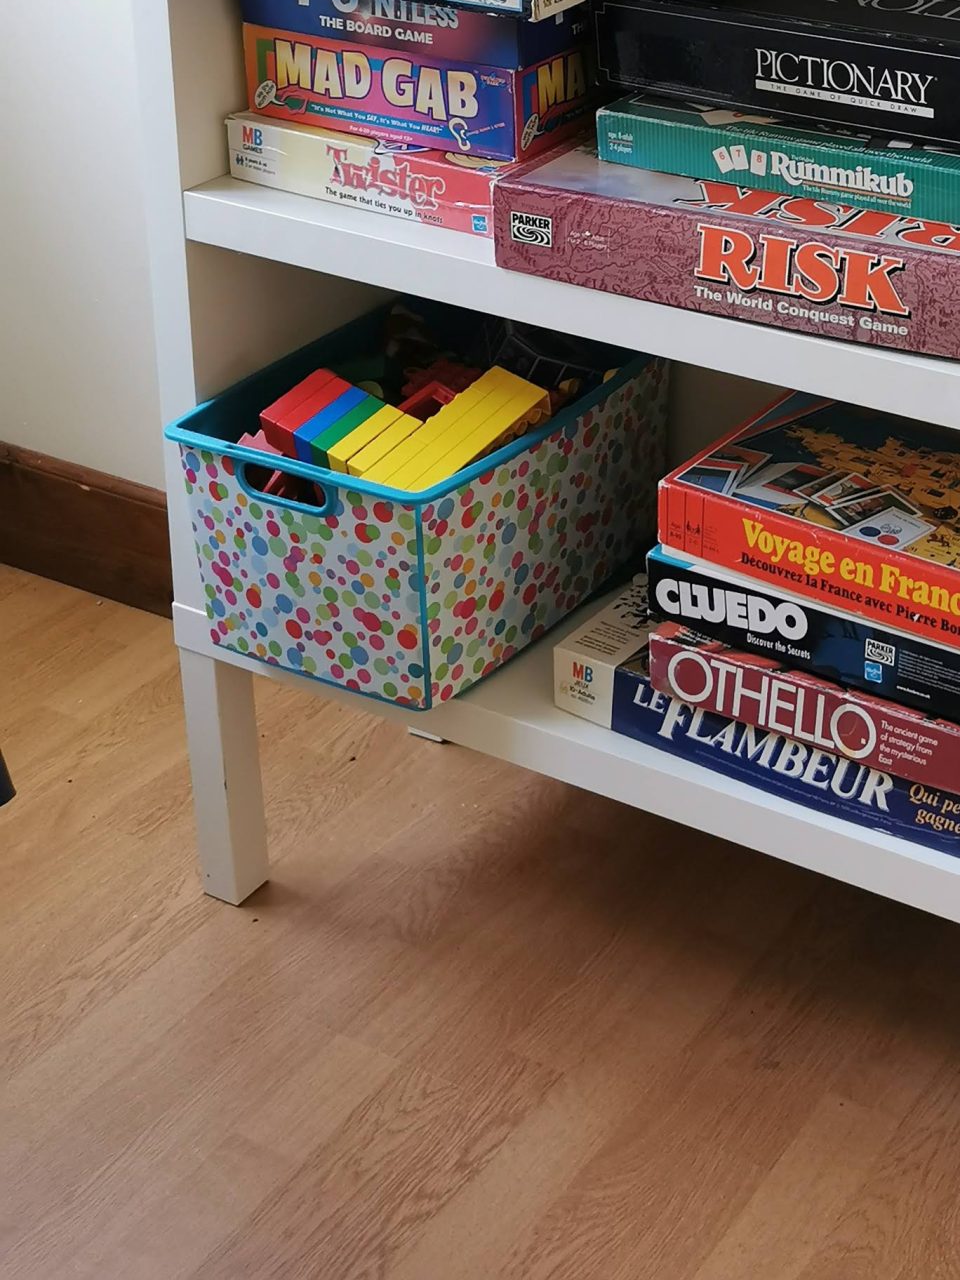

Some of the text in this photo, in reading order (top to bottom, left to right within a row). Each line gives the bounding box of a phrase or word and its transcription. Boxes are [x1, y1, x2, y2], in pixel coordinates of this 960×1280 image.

[319, 15, 434, 45] THE BOARD GAME
[272, 37, 479, 120] MAD GAB
[754, 47, 934, 105] PICTIONARY
[770, 84, 919, 114] THE GAME OF QUICK DRAW
[325, 107, 336, 115] Not
[337, 110, 353, 118] What
[391, 119, 407, 128] What
[409, 122, 420, 130] You
[242, 125, 263, 146] MB
[242, 143, 263, 154] GAMES
[718, 151, 725, 161] 6
[735, 149, 741, 158] 7
[755, 154, 762, 163] 8
[325, 145, 447, 211] Twister
[770, 151, 914, 197] Rummikub
[325, 186, 443, 224] The game that ties you up in knots
[512, 213, 551, 230] PARKER
[695, 223, 909, 317] RISK
[693, 285, 909, 336] The World Conquest Game
[741, 517, 836, 576] Voyage
[839, 557, 875, 589] en
[740, 552, 804, 584] Découvrez
[805, 573, 818, 588] la
[820, 579, 863, 604] France
[864, 596, 892, 613] avec
[896, 602, 938, 628] Pierre
[655, 578, 808, 641] CLUEDO
[746, 632, 811, 660] Discover the Secrets
[867, 639, 895, 655] PARKER
[573, 661, 593, 683] MB
[633, 683, 666, 714] LE
[667, 650, 877, 759] OTHELLO
[879, 732, 933, 756] of strategy from
[880, 720, 939, 746] The ancient game
[657, 698, 894, 812] FLAMBEUR
[878, 754, 893, 766] East
[879, 742, 928, 766] the mysterious
[909, 783, 939, 808] Qui
